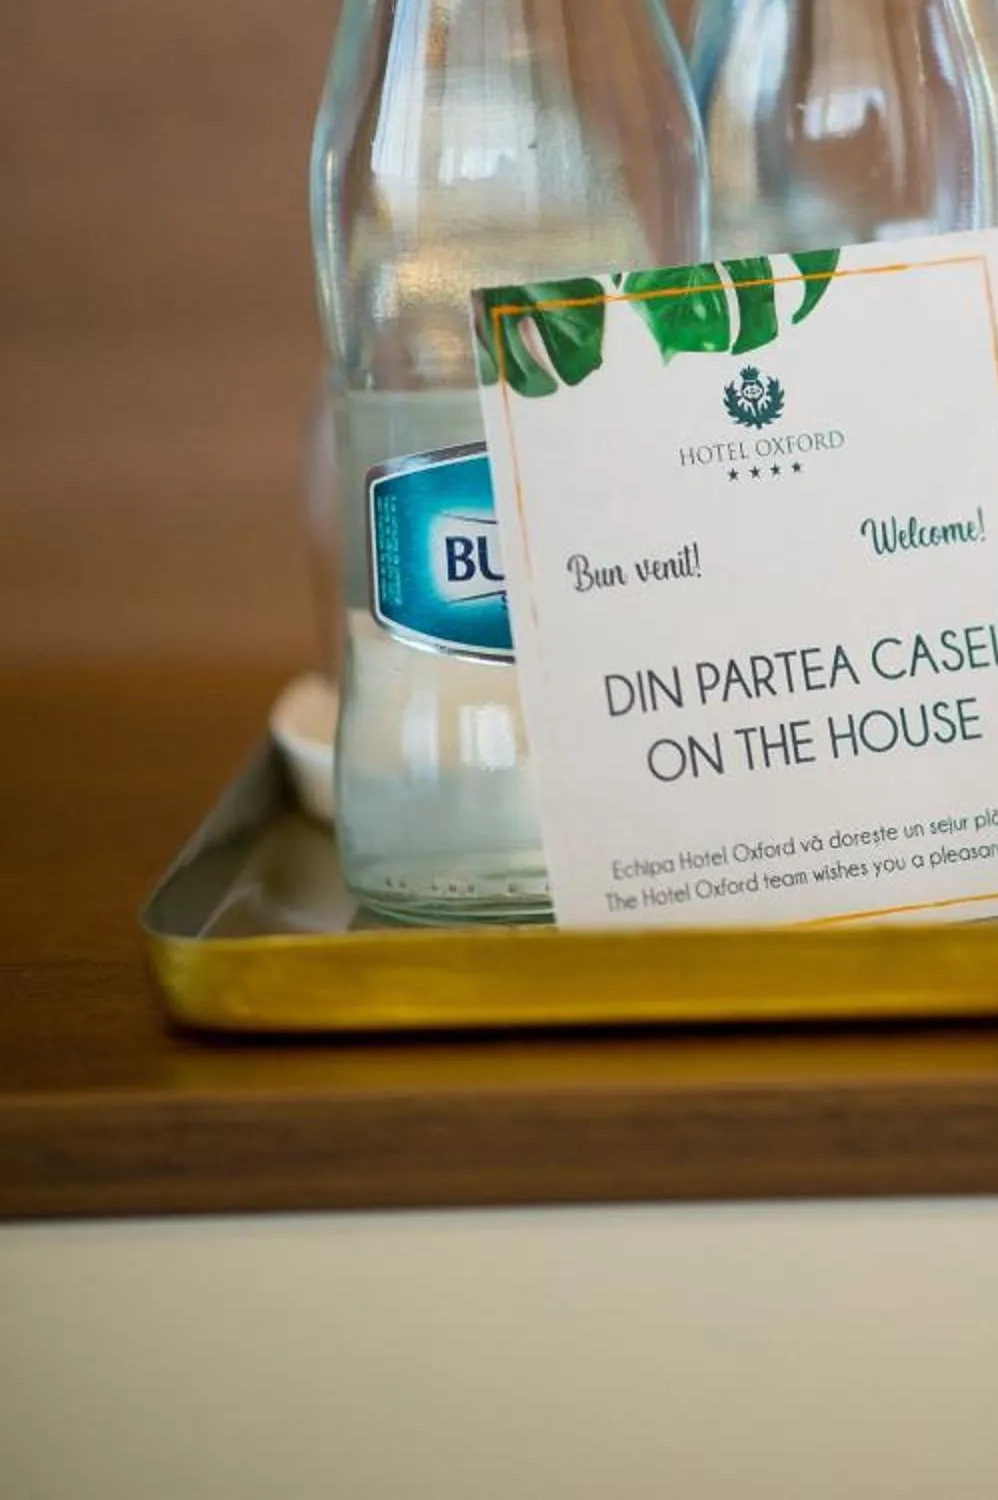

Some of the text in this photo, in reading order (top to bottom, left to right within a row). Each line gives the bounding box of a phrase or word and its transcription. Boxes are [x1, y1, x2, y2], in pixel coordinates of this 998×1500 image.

[679, 429, 845, 467] HOTEL OXFORD
[859, 506, 987, 556] Welcome!
[566, 541, 702, 593] Bun venit!
[604, 665, 684, 717] DIN
[695, 644, 860, 706] PARTEA
[647, 697, 983, 782] ON THE HOUSE
[611, 856, 676, 881] Echipa
[678, 845, 729, 871] Hotel
[732, 836, 796, 863] Oxford
[903, 822, 925, 839] un
[929, 815, 969, 835] sejur
[605, 891, 638, 912] The
[641, 883, 692, 908] Hotel
[695, 872, 760, 900] Oxford
[763, 870, 809, 890] team
[812, 859, 869, 883] wishes
[872, 857, 906, 878] you
[911, 853, 926, 869] a
